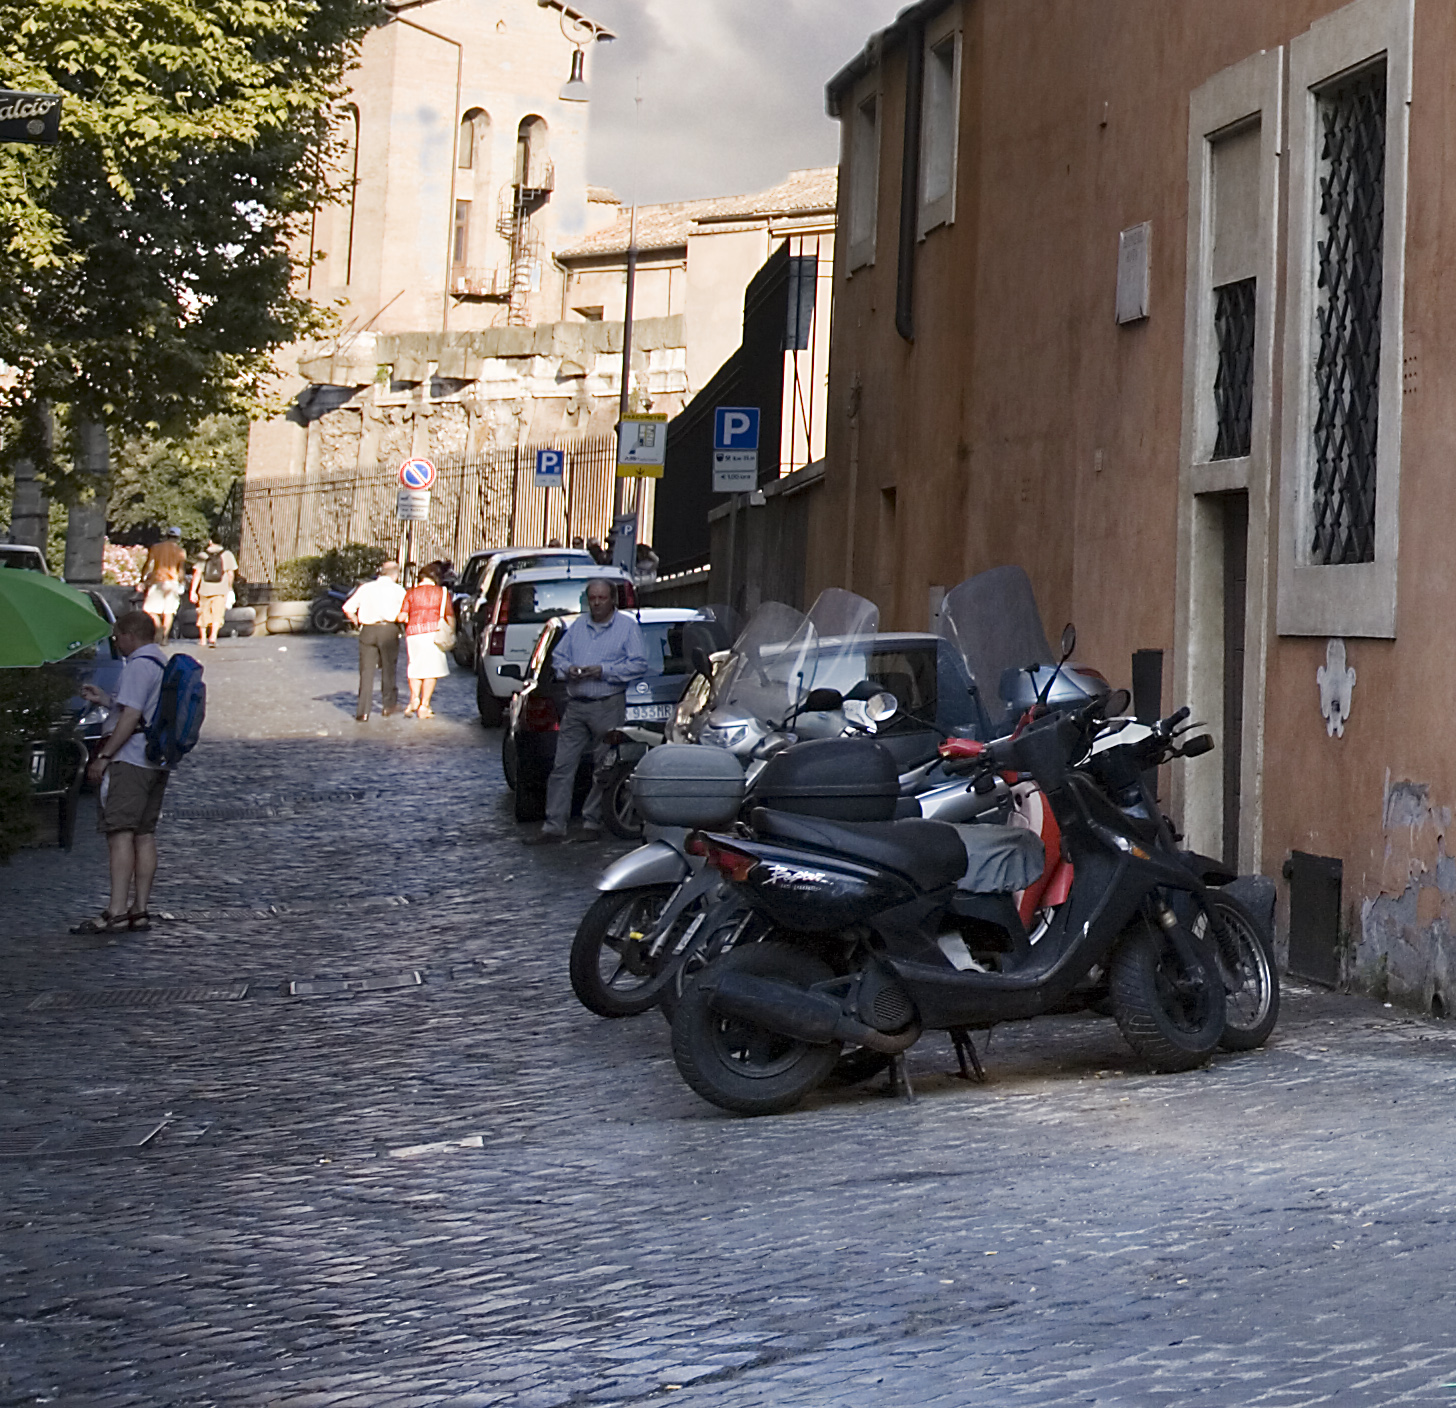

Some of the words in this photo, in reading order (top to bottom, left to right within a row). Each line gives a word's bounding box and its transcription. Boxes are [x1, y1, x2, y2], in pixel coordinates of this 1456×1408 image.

[0, 98, 54, 121] alcio
[723, 412, 751, 446] P
[541, 452, 558, 473] P
[624, 524, 633, 535] P
